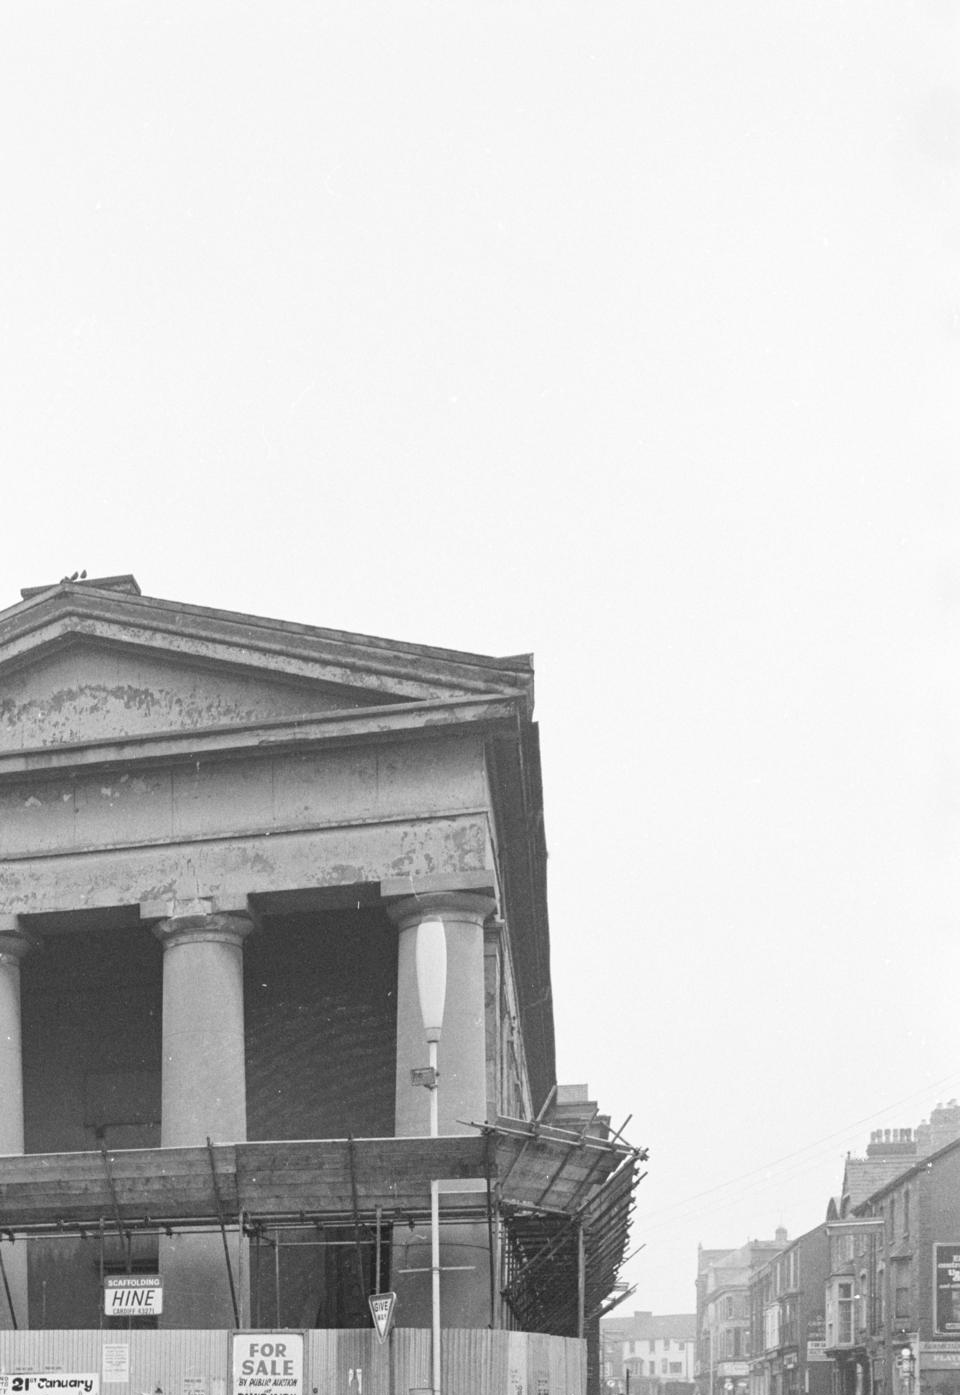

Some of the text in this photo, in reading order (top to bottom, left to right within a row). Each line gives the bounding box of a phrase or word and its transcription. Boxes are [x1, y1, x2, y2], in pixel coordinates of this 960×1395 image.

[107, 1278, 160, 1287] SCAFFOLDING
[112, 1289, 155, 1307] HINE
[374, 1300, 389, 1312] GIVE
[249, 1343, 287, 1358] FOR
[242, 1359, 294, 1376] SALE
[38, 1378, 94, 1392] January
[238, 1378, 298, 1387] BY PUBLIC AUCTION
